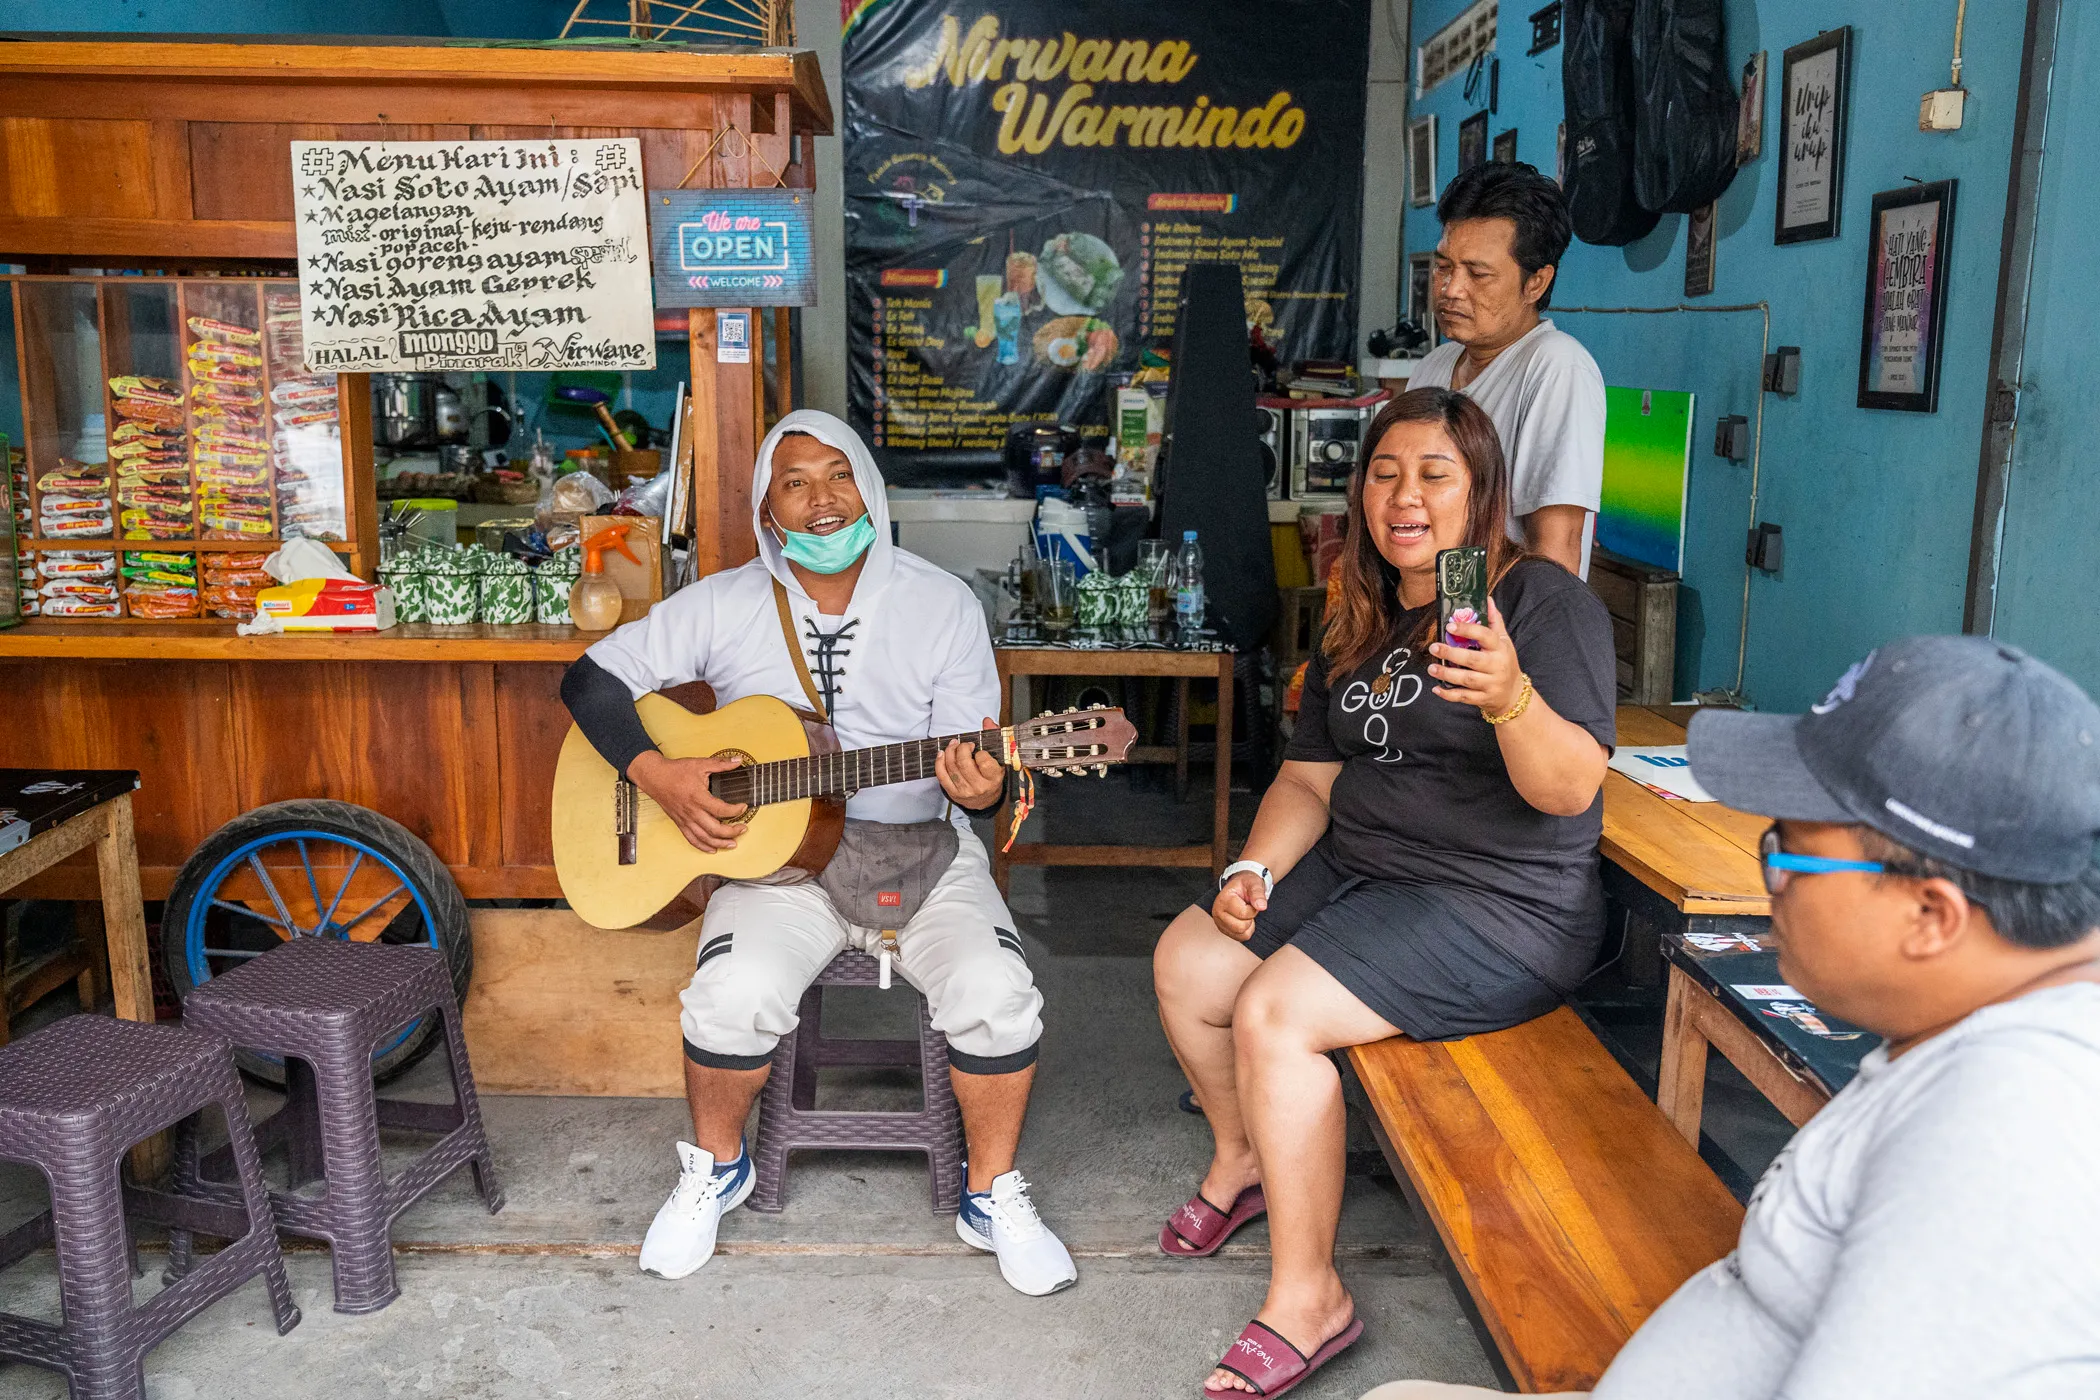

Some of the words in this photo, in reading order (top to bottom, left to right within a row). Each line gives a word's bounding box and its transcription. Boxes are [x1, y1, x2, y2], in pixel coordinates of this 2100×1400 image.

[904, 15, 1199, 89] Nirwana
[1795, 82, 1831, 122] Urip
[992, 83, 1305, 154] Warmindo
[338, 146, 438, 176] Menu
[438, 145, 510, 171] Hari
[318, 177, 387, 202] Nasi
[394, 173, 469, 201] Soto
[702, 211, 732, 232] We
[735, 215, 760, 231] are
[692, 235, 775, 260] OPEN
[1888, 231, 1906, 257] HATI
[1906, 225, 1928, 253] YANG
[321, 250, 383, 274] Nasi
[385, 253, 484, 277] goreng
[486, 250, 571, 275] ayam
[1883, 255, 1927, 290] GEMBIRA
[323, 276, 385, 302] Nasi
[386, 276, 476, 305] Ayam
[710, 276, 761, 287] WELCOME
[325, 302, 392, 328] Nasi
[389, 302, 476, 331] Rica
[476, 299, 592, 340] Ayam
[315, 345, 389, 365] HALAL
[529, 332, 647, 367] Nirwana
[562, 360, 618, 368] WARMINDO
[1257, 1350, 1274, 1370] The
